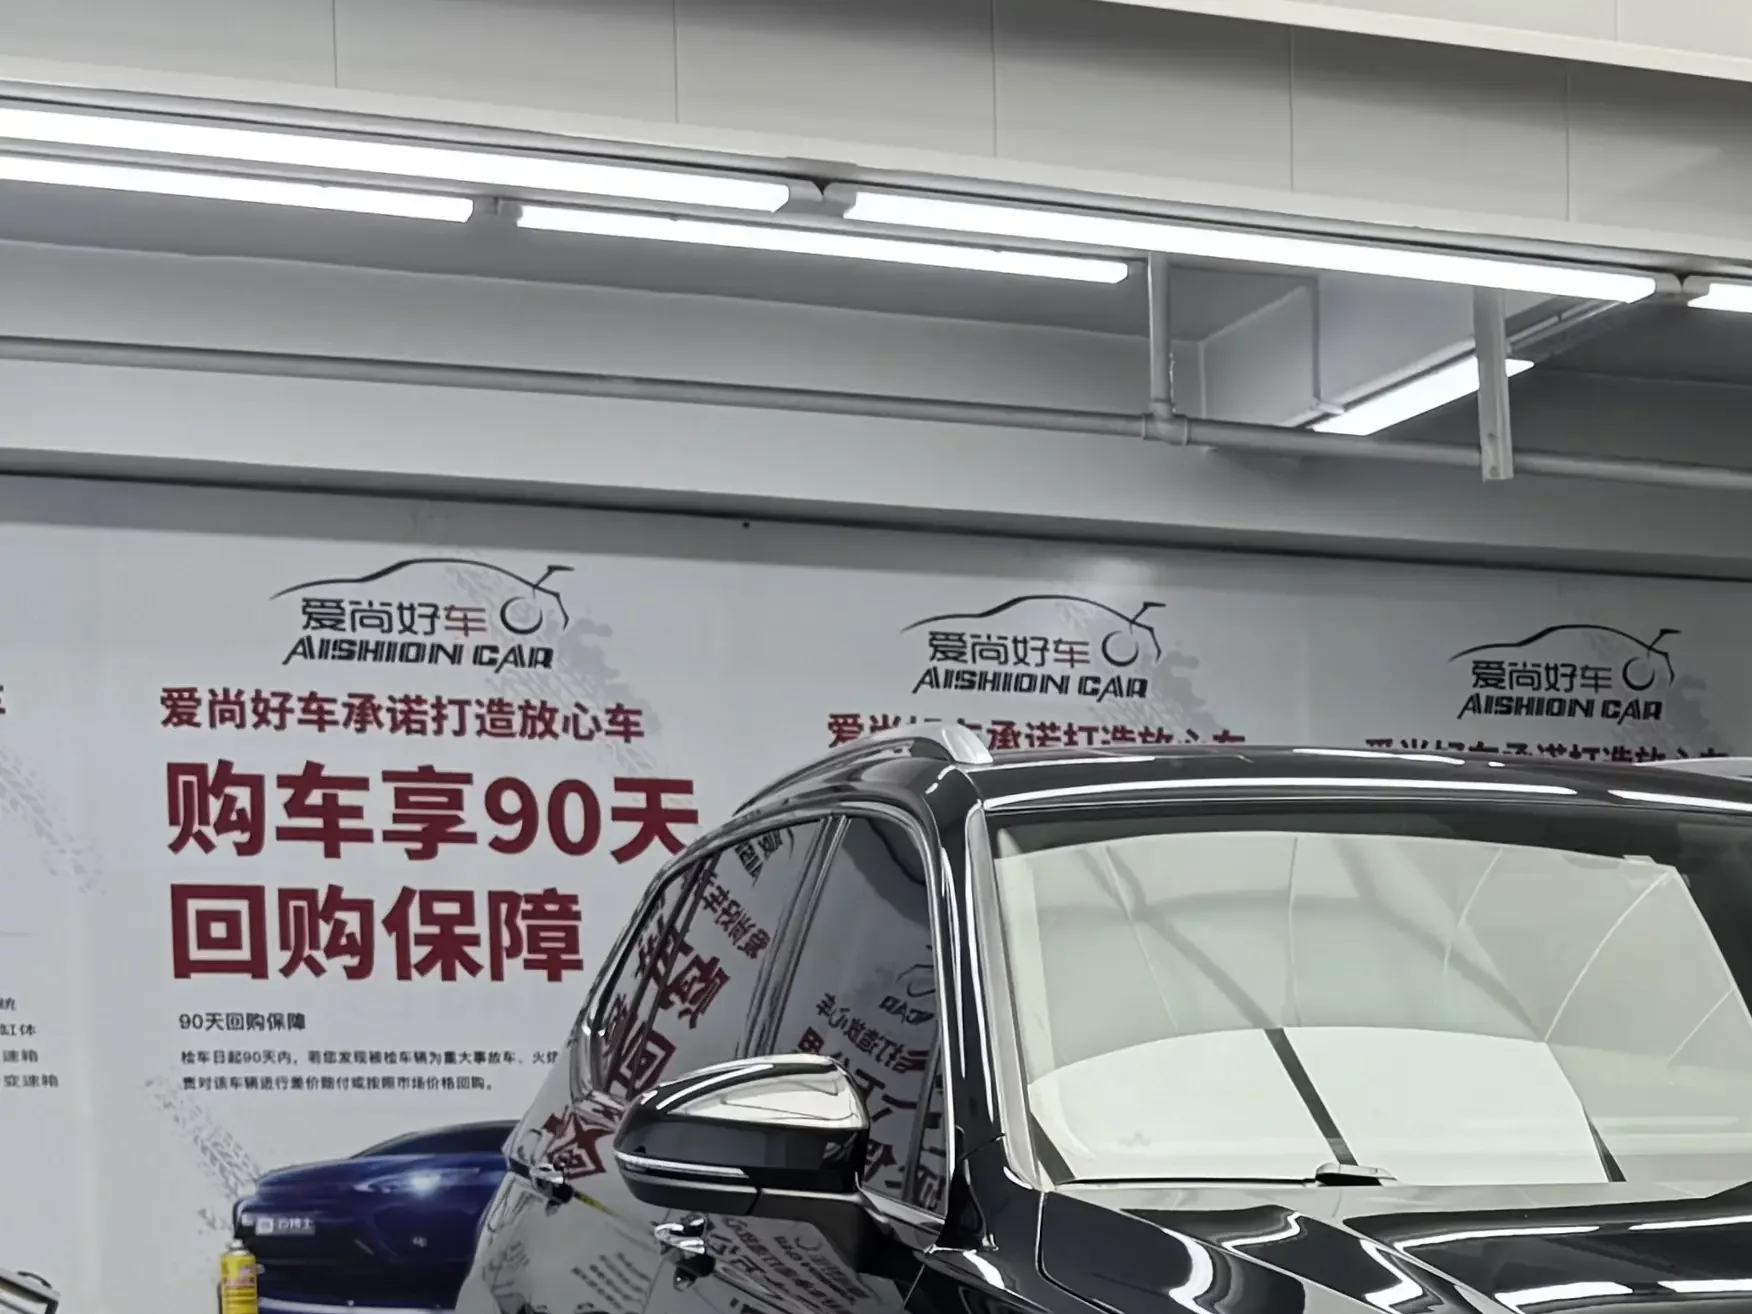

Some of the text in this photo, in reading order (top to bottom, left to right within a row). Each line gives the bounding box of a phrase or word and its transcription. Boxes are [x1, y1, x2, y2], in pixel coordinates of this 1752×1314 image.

[301, 597, 487, 637] 爱尚好车
[282, 635, 554, 673] AISHION CAR
[928, 630, 1090, 669] 爱尚好车
[911, 666, 1148, 702] AISHION CAR
[1472, 660, 1612, 693] 爱尚好车
[160, 686, 644, 743] 爱尚好车承诺打造放心车
[1457, 693, 1662, 725] AISHION CAR
[165, 759, 699, 863] 购车享90天
[169, 882, 584, 982] 回购保障
[179, 1012, 306, 1031] 90天回购保障
